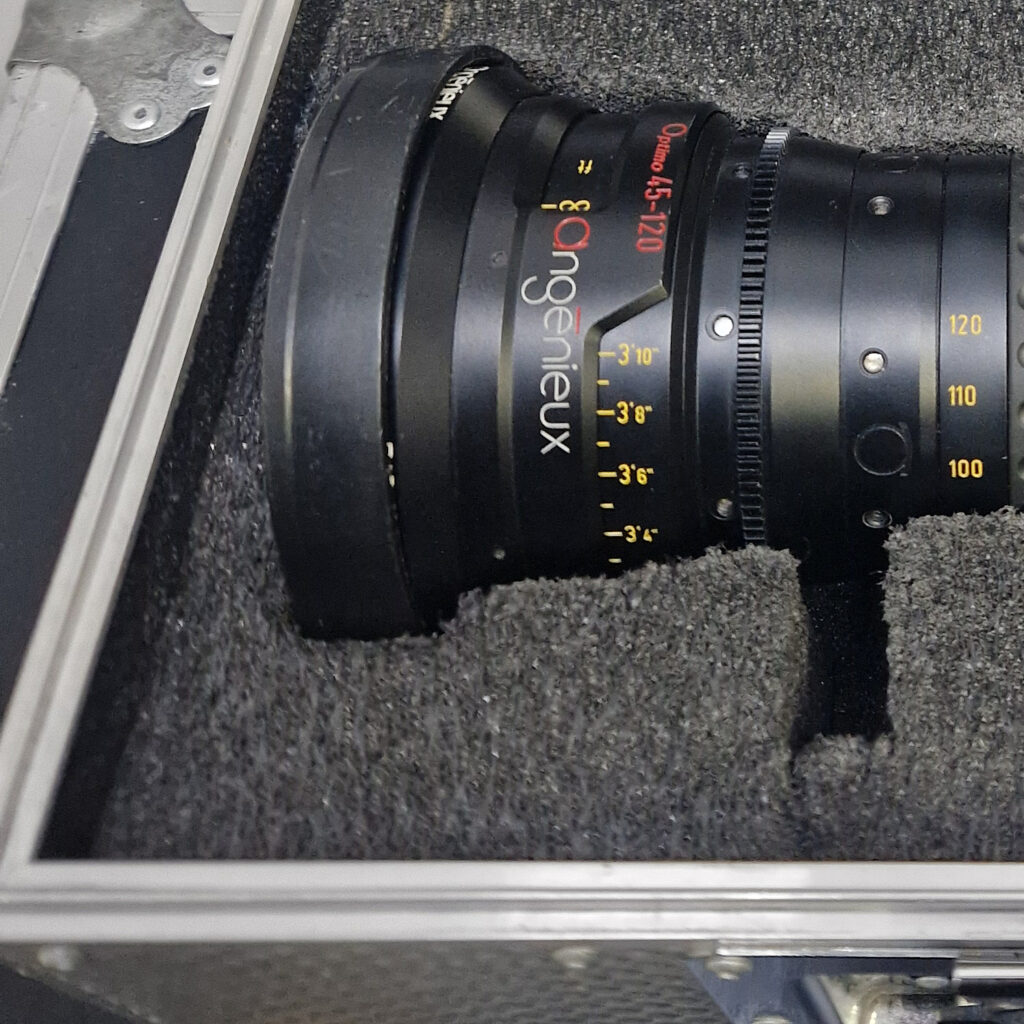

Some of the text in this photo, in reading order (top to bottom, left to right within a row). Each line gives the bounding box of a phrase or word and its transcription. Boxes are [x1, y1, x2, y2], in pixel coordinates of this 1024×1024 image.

[636, 123, 688, 253] Optimo 45-120
[949, 314, 982, 336] 120
[947, 384, 978, 407] 110
[948, 458, 984, 479] 100
